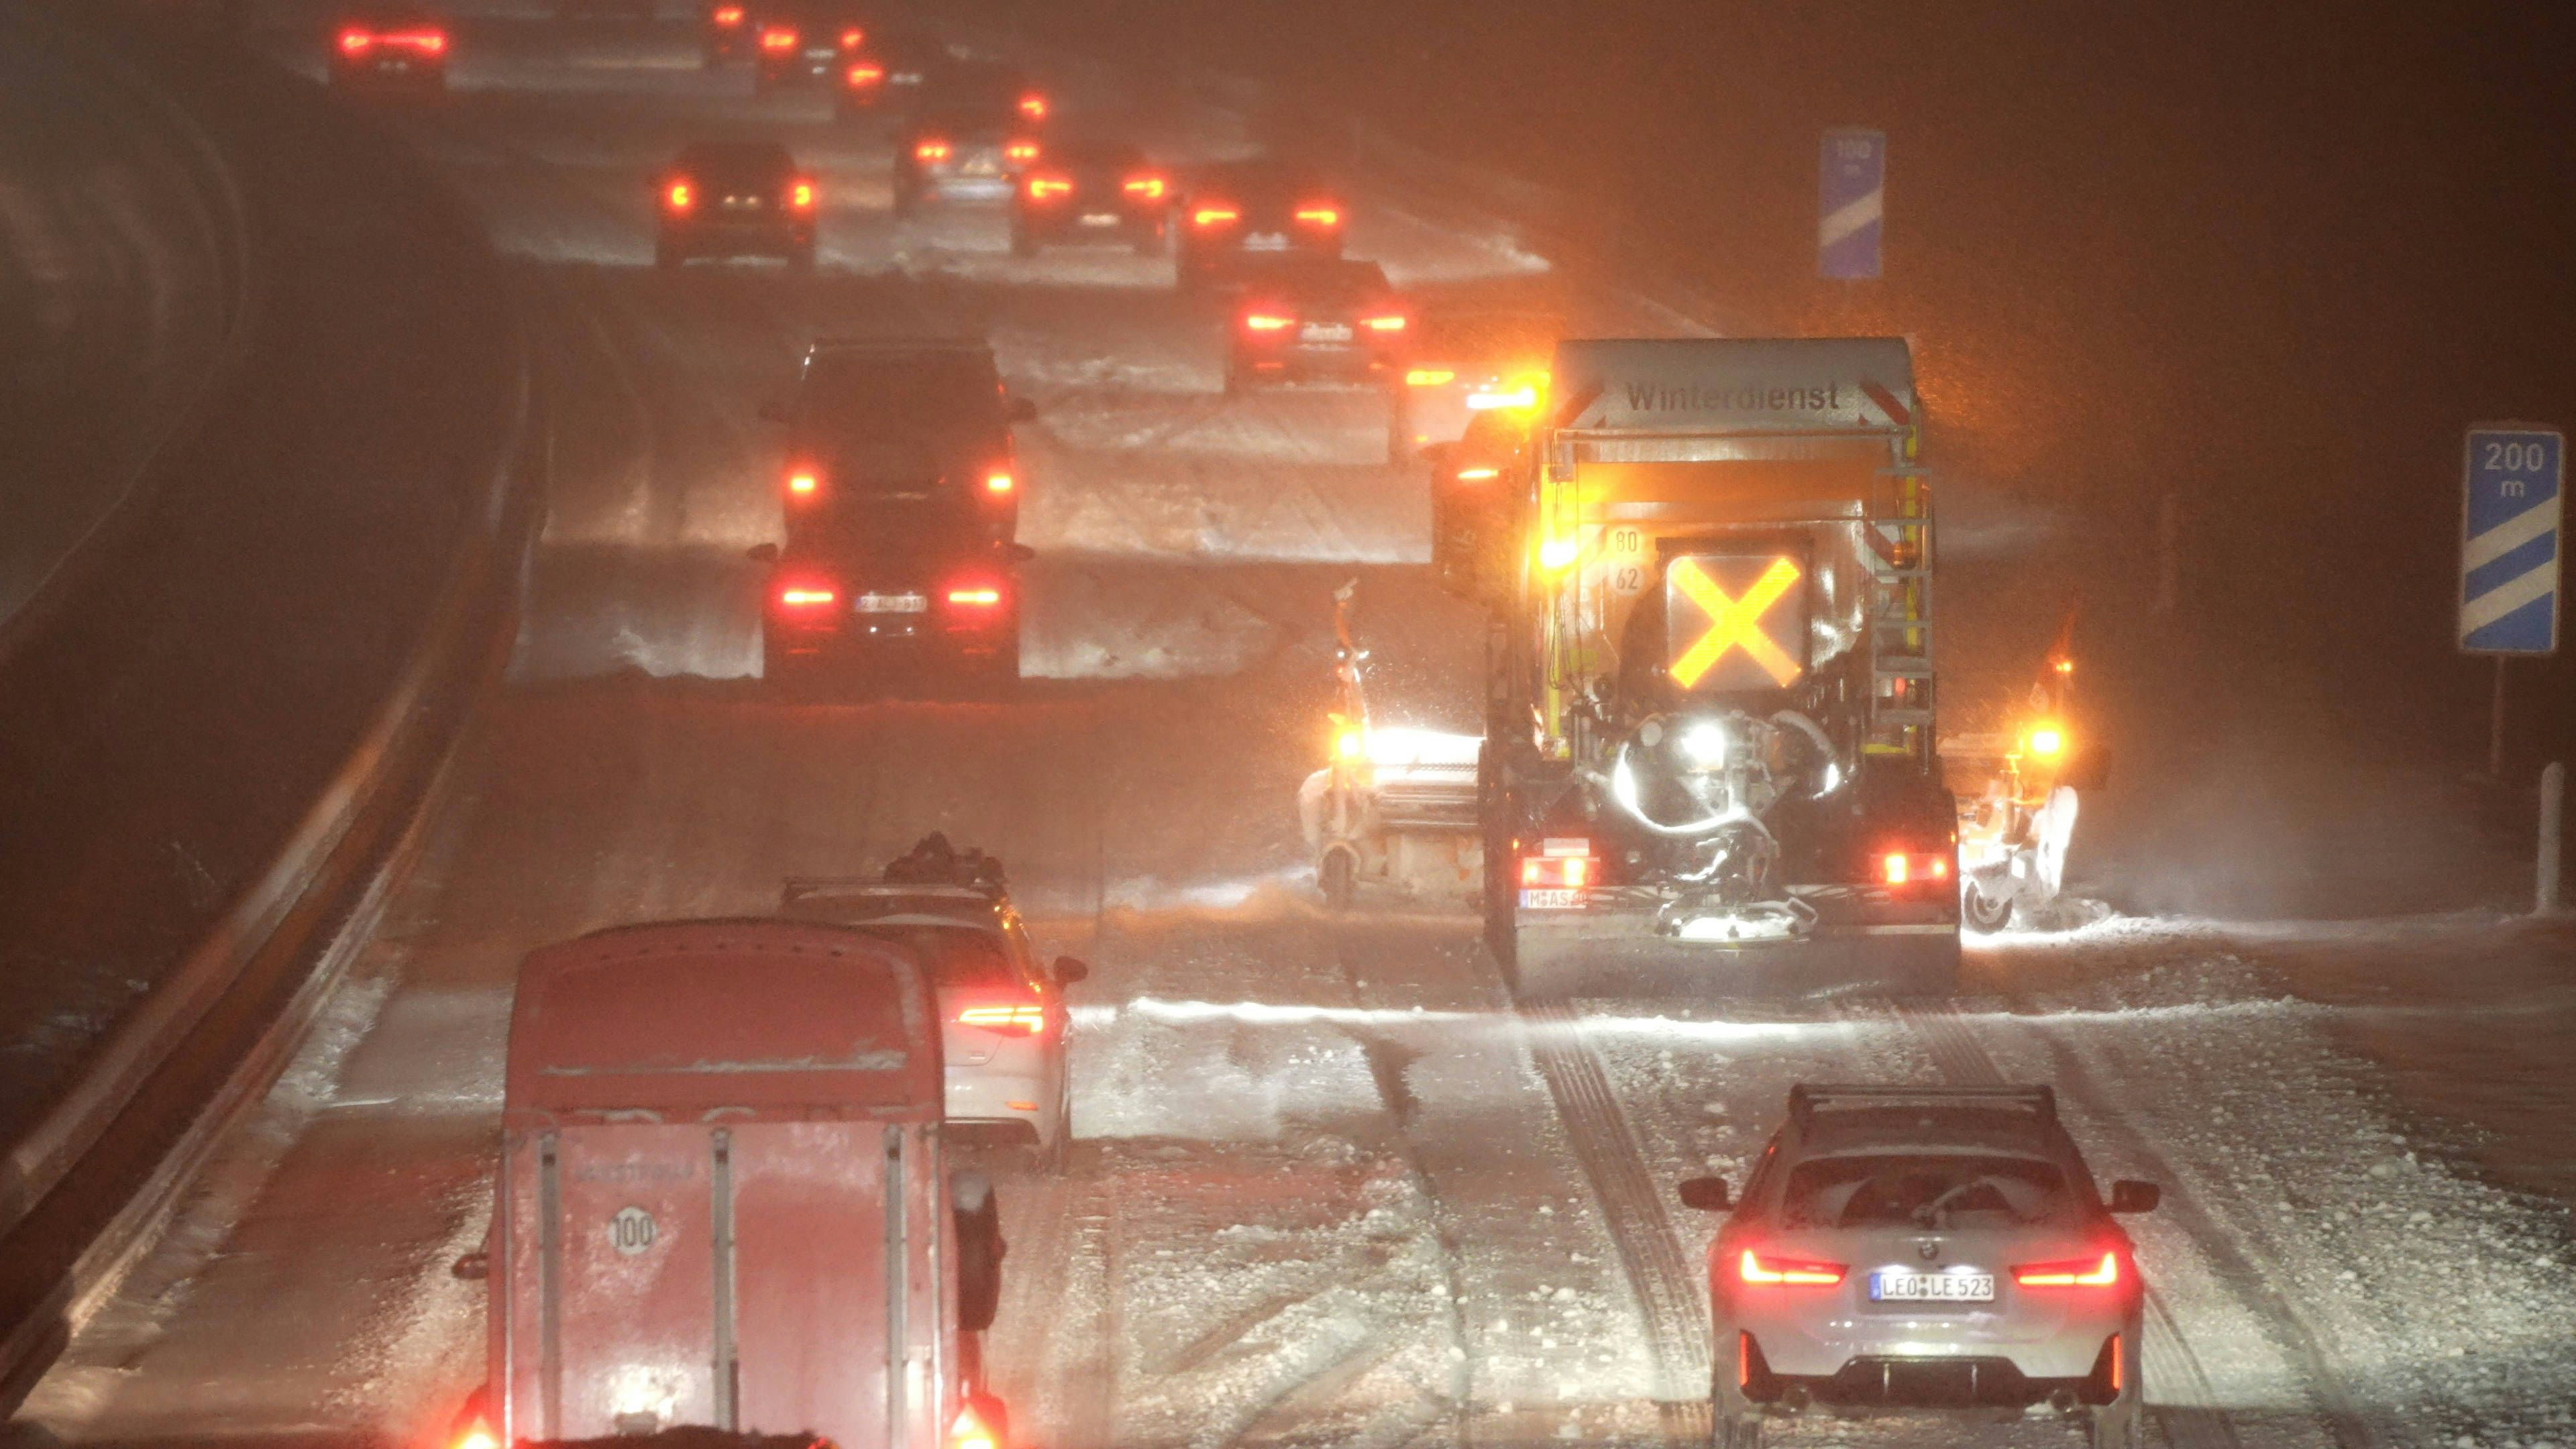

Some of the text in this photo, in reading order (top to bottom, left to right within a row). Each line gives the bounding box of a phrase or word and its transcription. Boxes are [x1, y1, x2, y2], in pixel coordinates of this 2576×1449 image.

[1625, 380, 1840, 411] Winterdienst
[2484, 441, 2545, 472] 200
[2500, 480, 2526, 498] m
[1616, 531, 1638, 552] 80
[1617, 568, 1638, 590] 62
[611, 1216, 653, 1247] 100
[1883, 1278, 1918, 1296] LEO
[1958, 1278, 1991, 1296] 523
